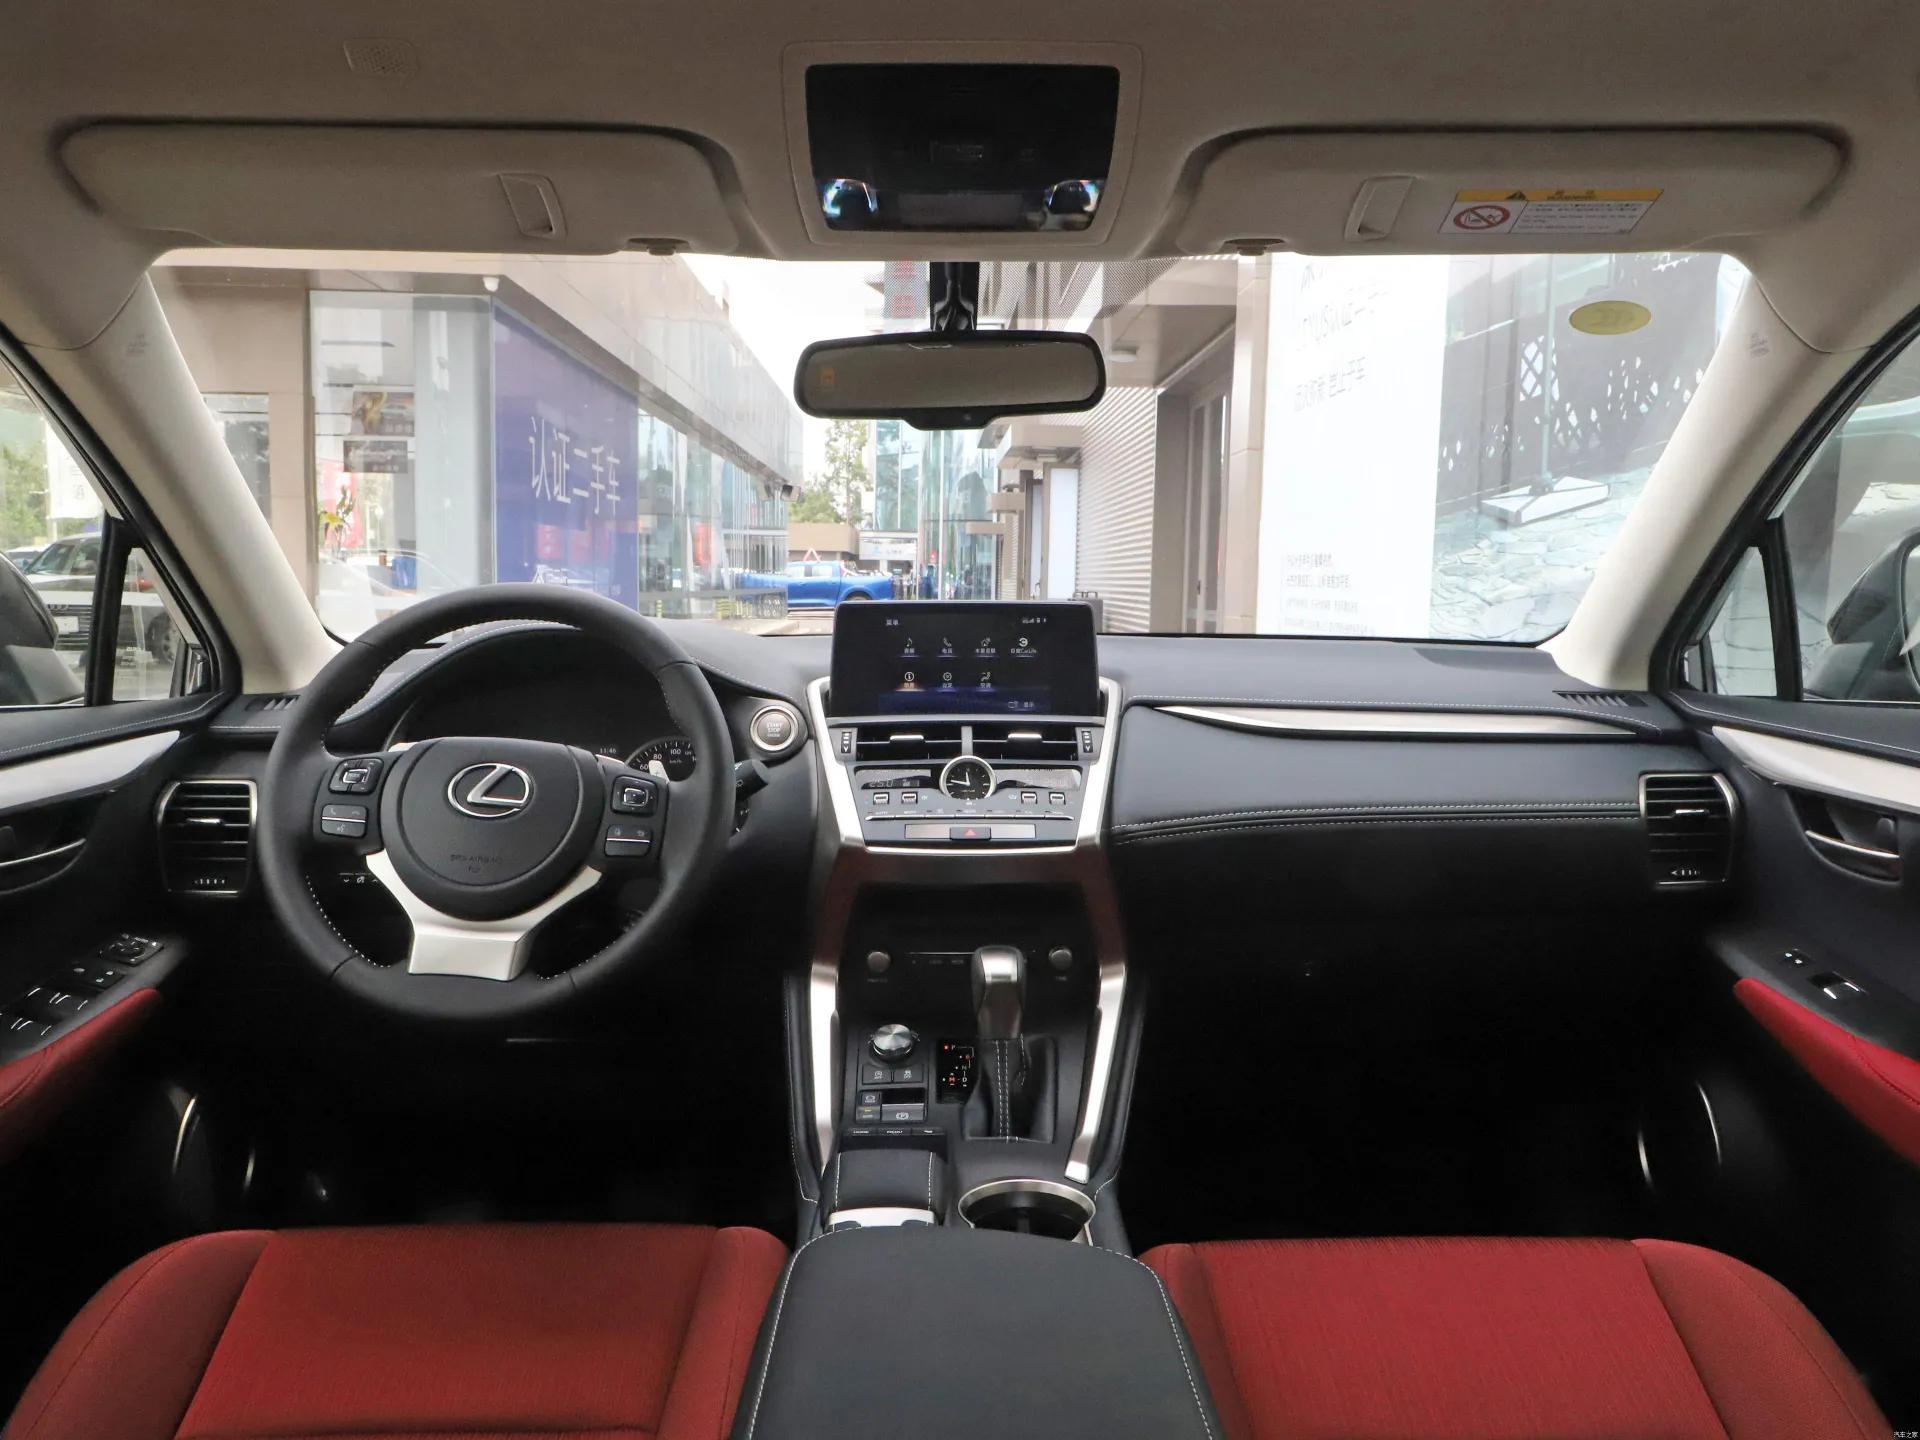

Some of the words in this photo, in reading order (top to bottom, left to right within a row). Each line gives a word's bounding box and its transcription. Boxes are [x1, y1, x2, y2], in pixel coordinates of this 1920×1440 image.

[529, 416, 621, 516] 认证二手车
